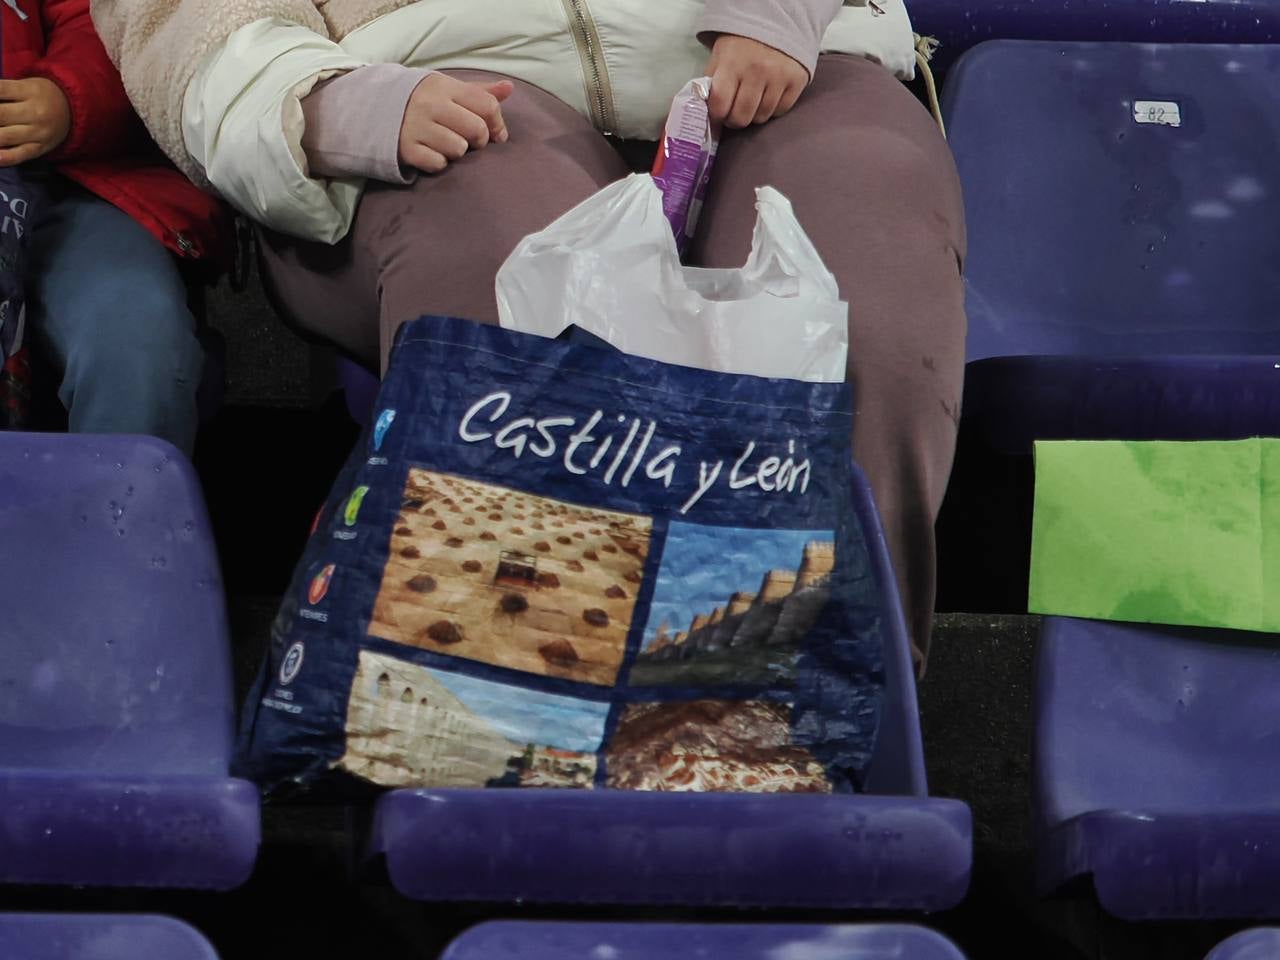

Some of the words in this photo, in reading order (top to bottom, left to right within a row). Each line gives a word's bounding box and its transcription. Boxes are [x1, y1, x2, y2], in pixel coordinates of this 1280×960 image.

[1148, 107, 1165, 122] 82
[458, 392, 682, 488] Castilla
[680, 460, 723, 515] y
[728, 439, 811, 494] León
